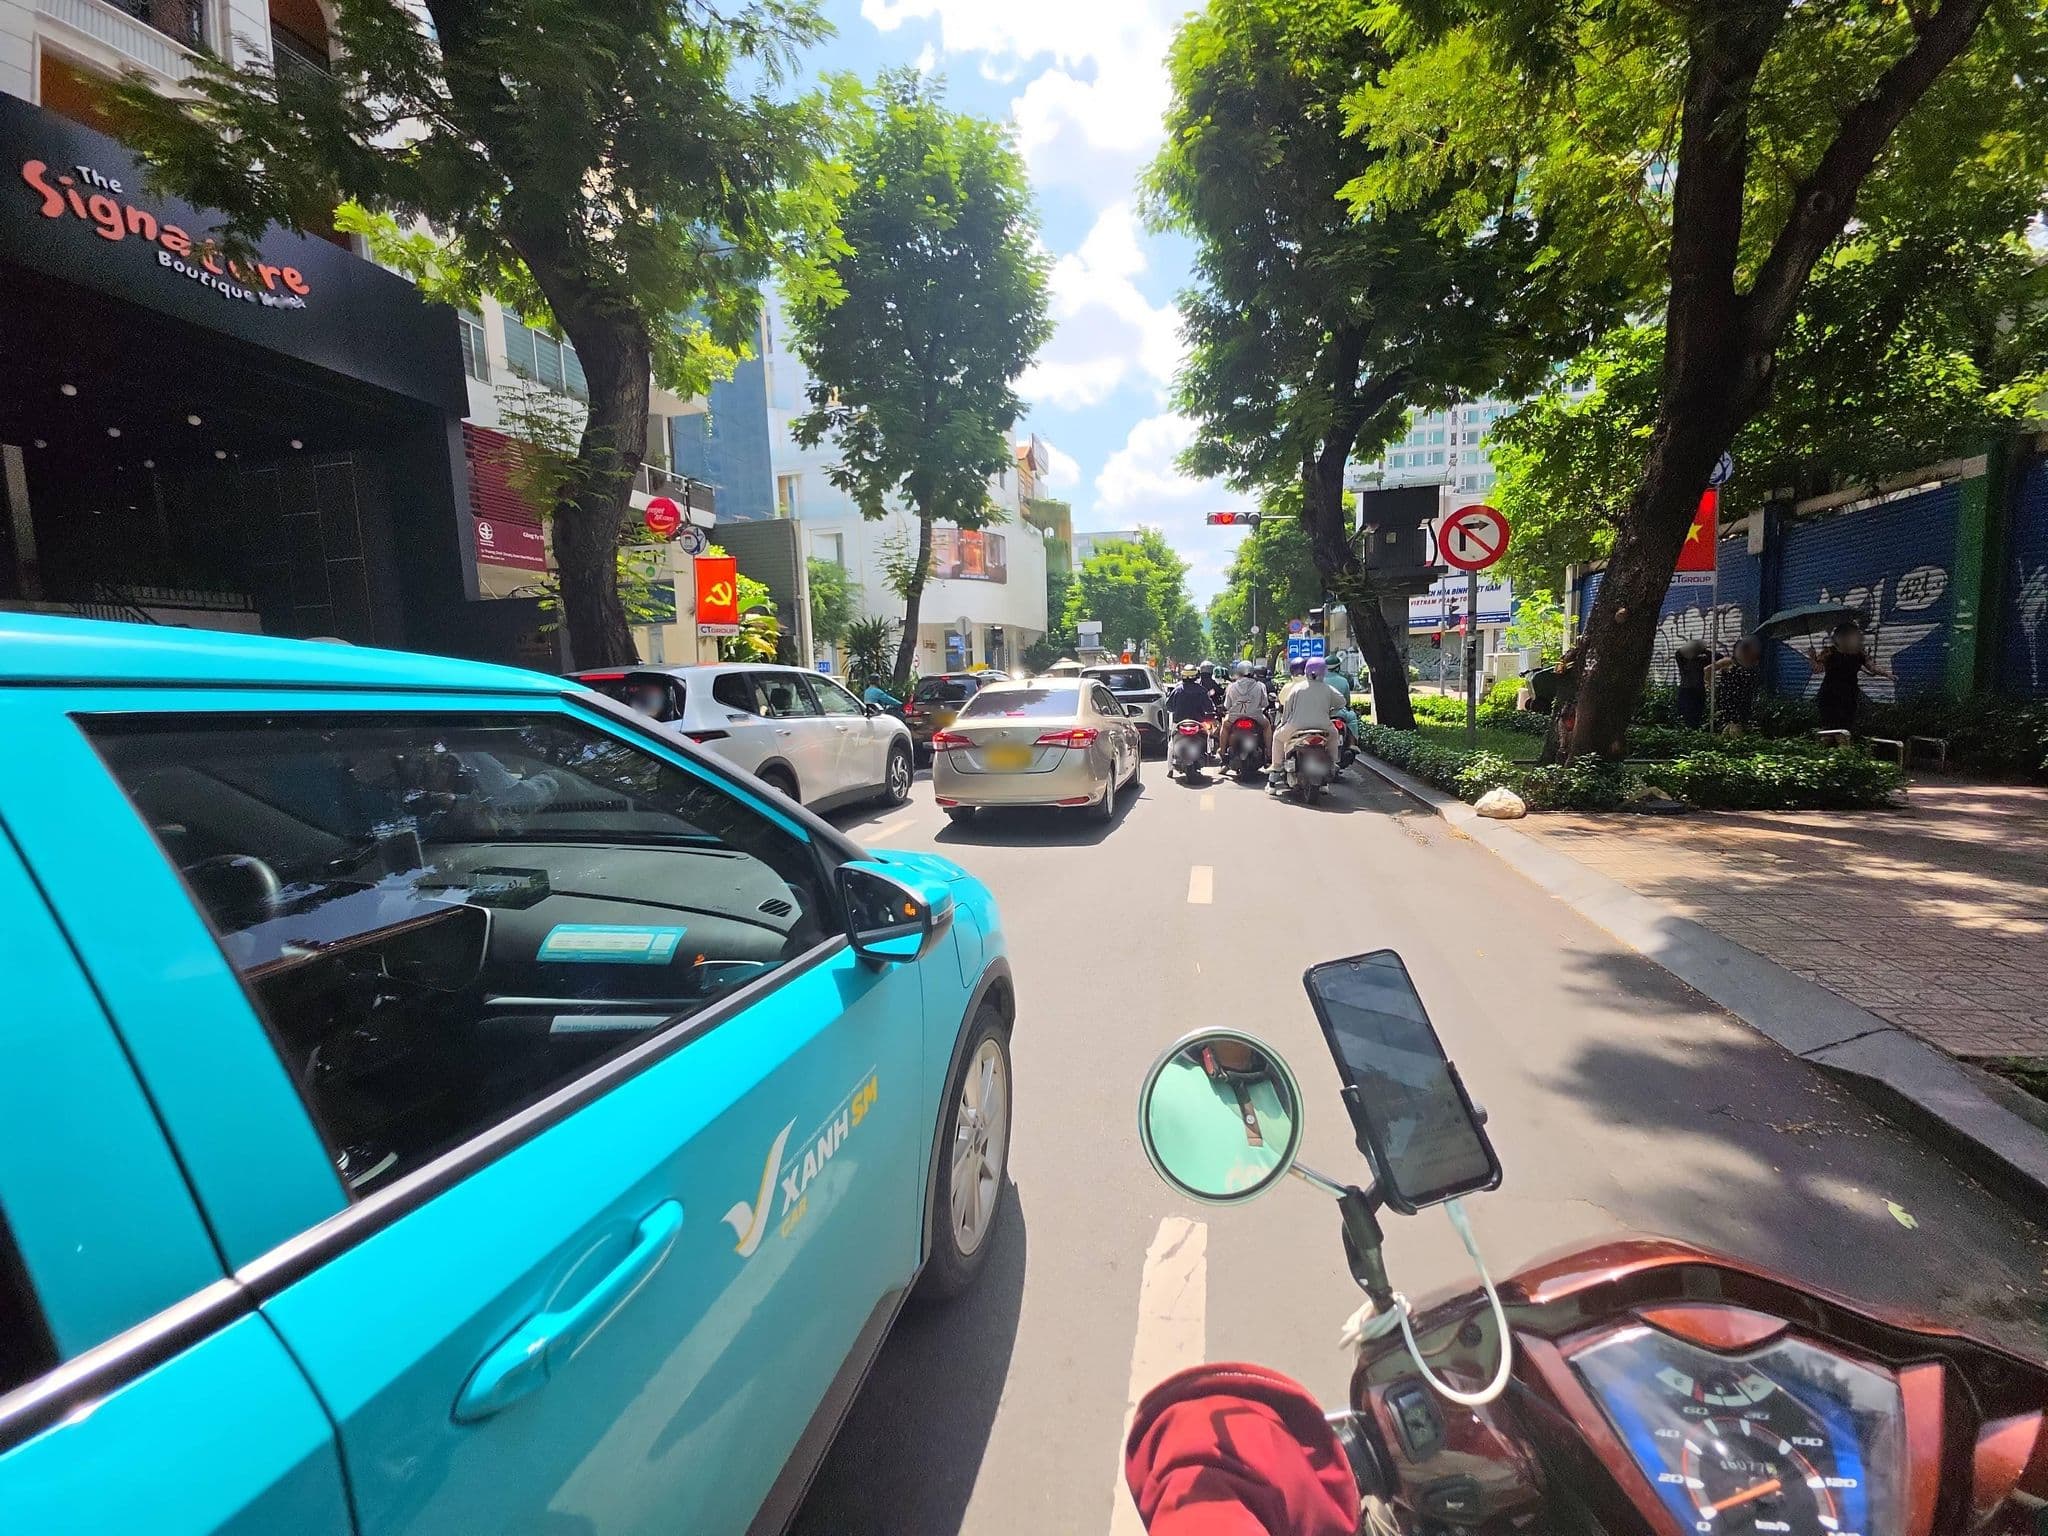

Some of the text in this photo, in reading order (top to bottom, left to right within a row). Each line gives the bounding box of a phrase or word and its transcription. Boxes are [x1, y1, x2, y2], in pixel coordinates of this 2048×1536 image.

[76, 165, 123, 194] The
[158, 251, 256, 303] Boutique
[782, 1108, 849, 1217] XANH
[851, 1074, 878, 1127] SM
[1655, 1428, 1680, 1438] 40
[1791, 1436, 1824, 1447] 100
[1658, 1473, 1684, 1484] 20
[1825, 1477, 1858, 1489] 120
[1696, 1521, 1712, 1532] 0
